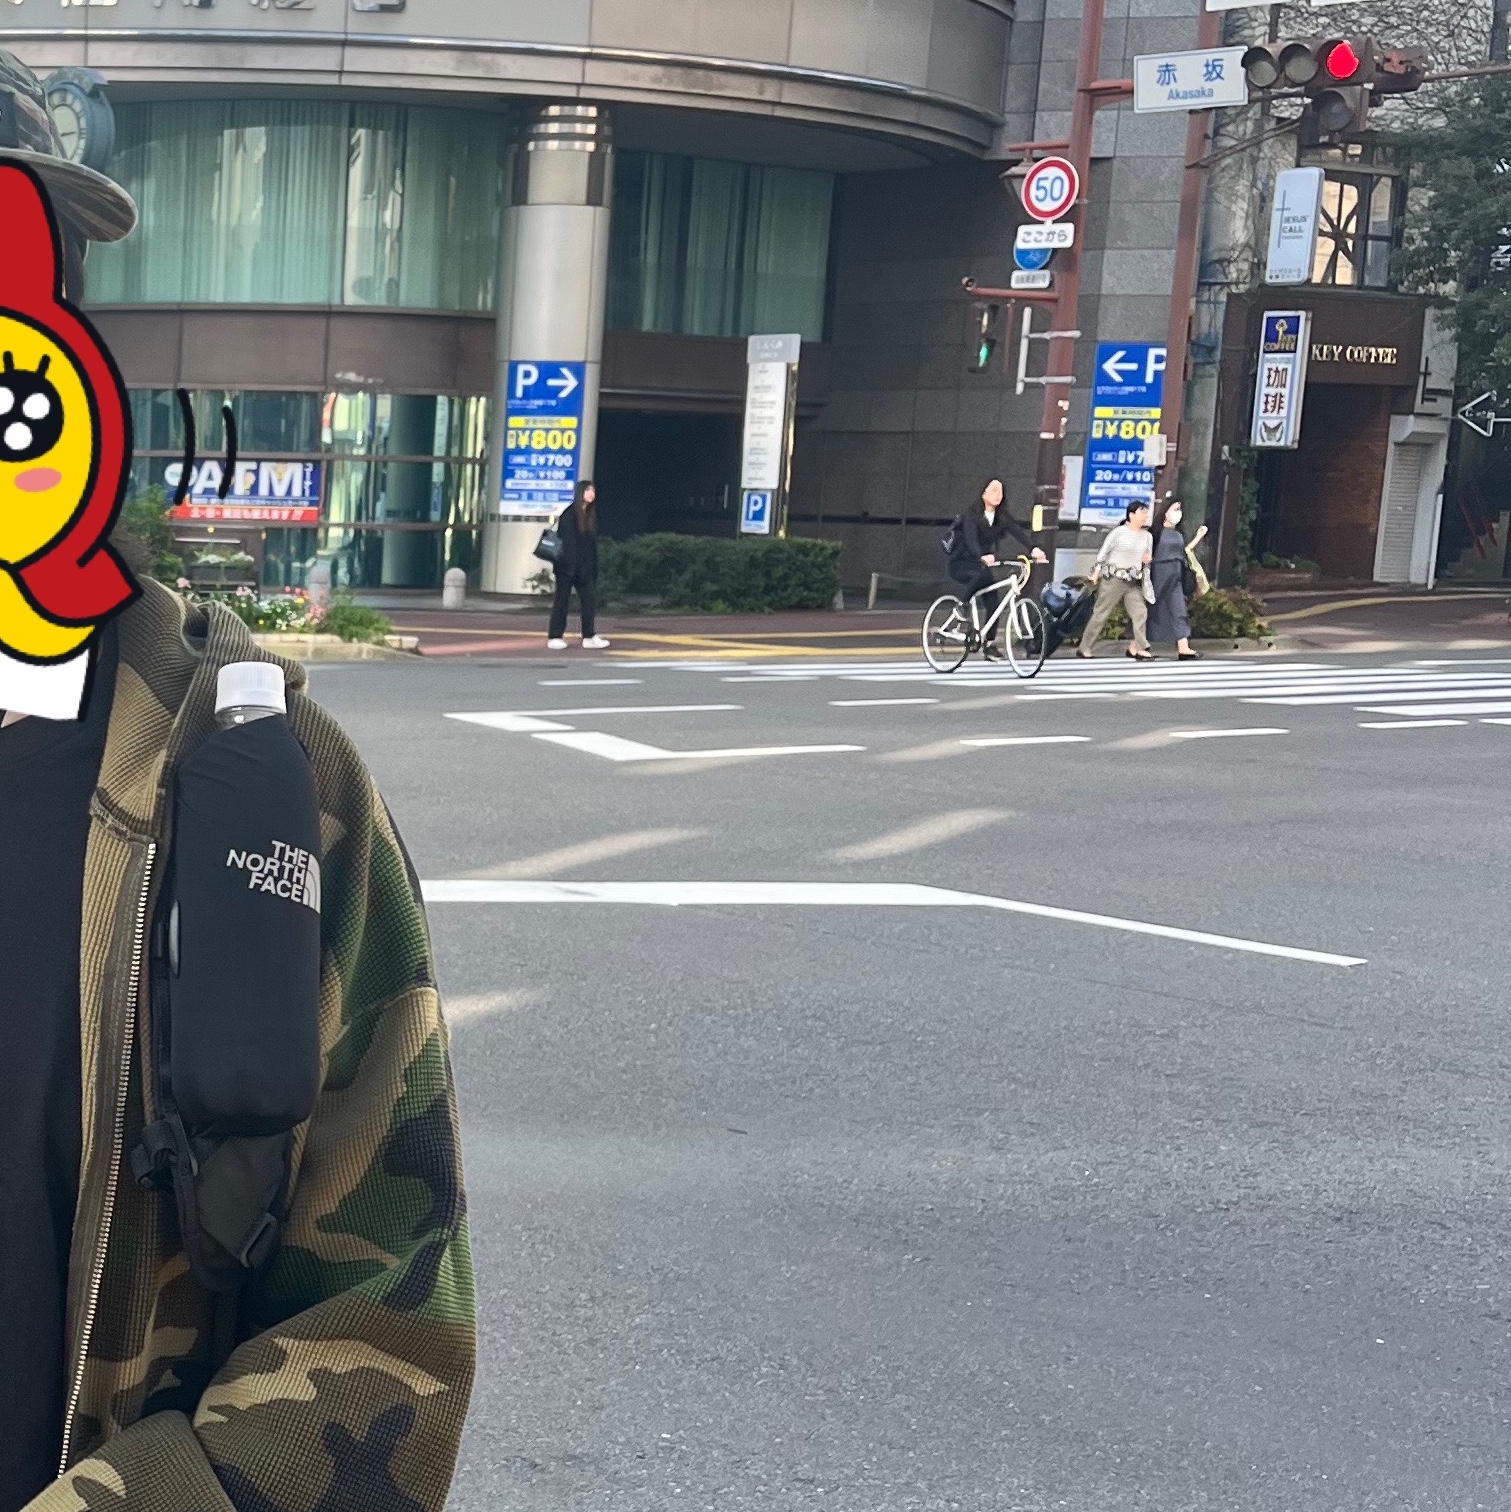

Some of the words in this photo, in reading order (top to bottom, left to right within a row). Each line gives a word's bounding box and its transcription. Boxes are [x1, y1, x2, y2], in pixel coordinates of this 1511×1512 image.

[1157, 58, 1224, 86] 赤坂
[1167, 86, 1214, 101] Akasaka
[1035, 176, 1065, 203] 50
[1021, 230, 1068, 243] ここから
[1145, 348, 1168, 384] P
[1311, 343, 1343, 362] KEY
[1345, 345, 1397, 364] COFFEE
[515, 364, 539, 398] P
[1263, 367, 1289, 415] 珈琲
[517, 430, 577, 450] ¥800
[192, 460, 304, 497] ATM
[226, 849, 306, 886] NORTH
[271, 840, 309, 869] THE
[248, 872, 304, 903] FACE
